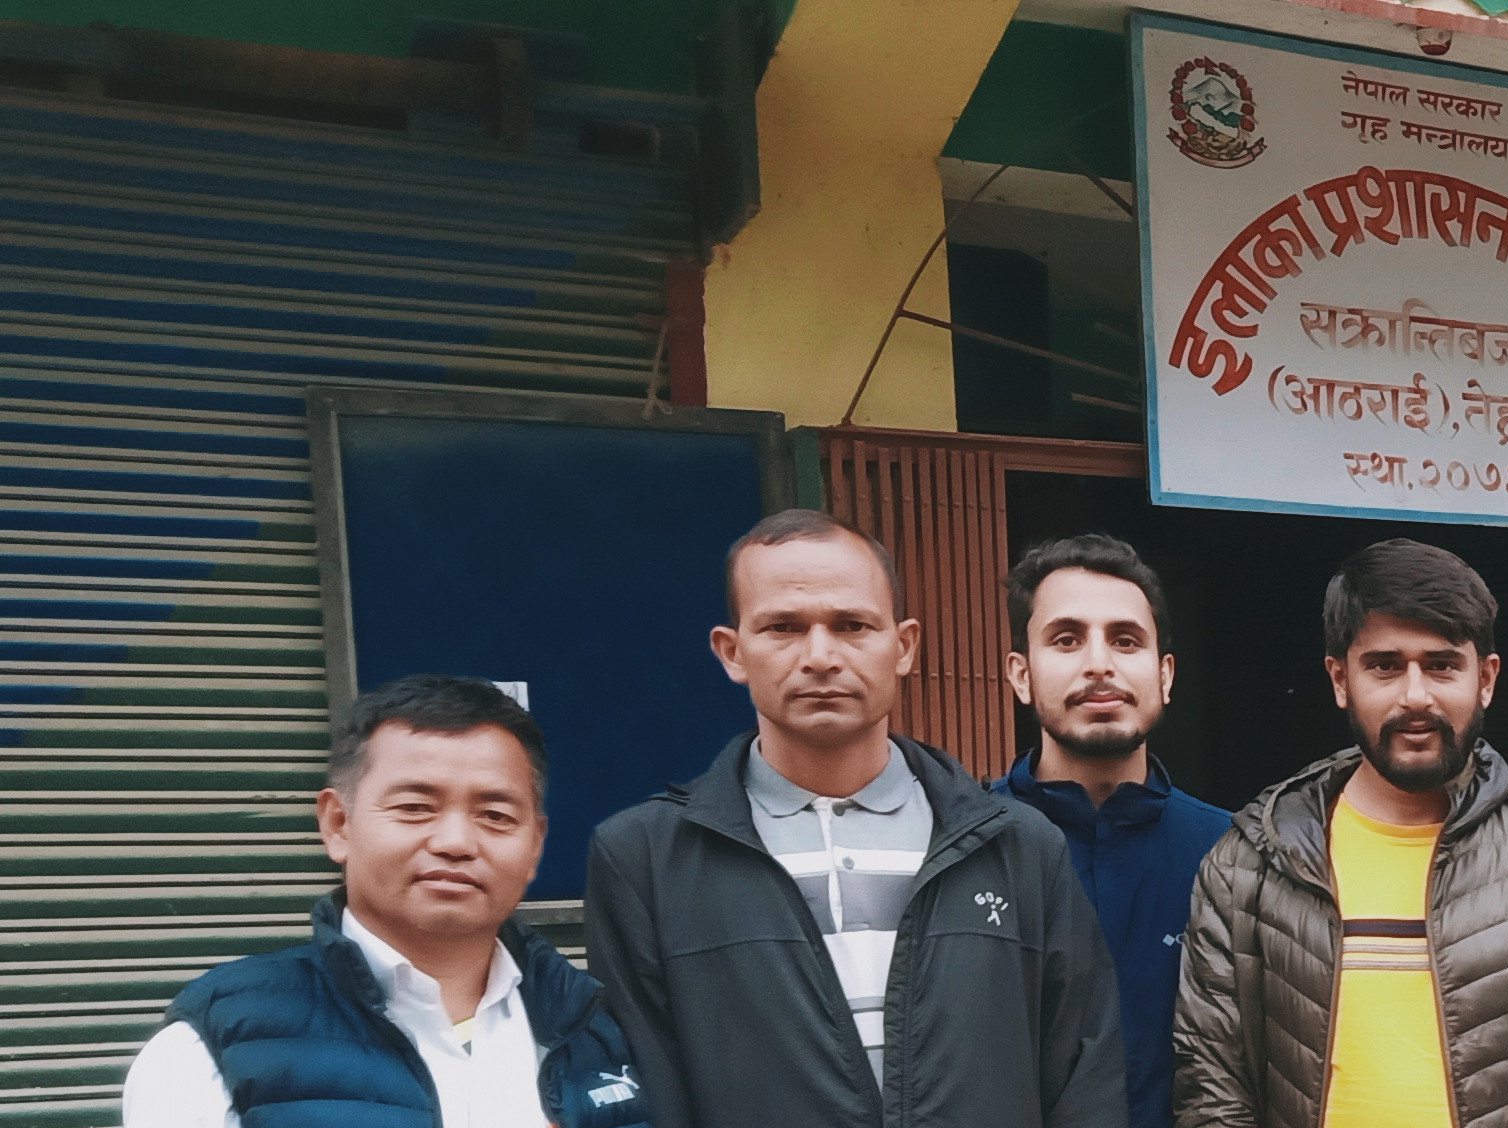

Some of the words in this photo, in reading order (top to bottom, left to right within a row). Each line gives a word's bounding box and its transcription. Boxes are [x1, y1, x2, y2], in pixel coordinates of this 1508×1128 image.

[1340, 70, 1411, 108] नेपाल
[1416, 89, 1504, 124] सरकार
[1340, 110, 1392, 145] गृह
[1168, 193, 1327, 397] इलाका
